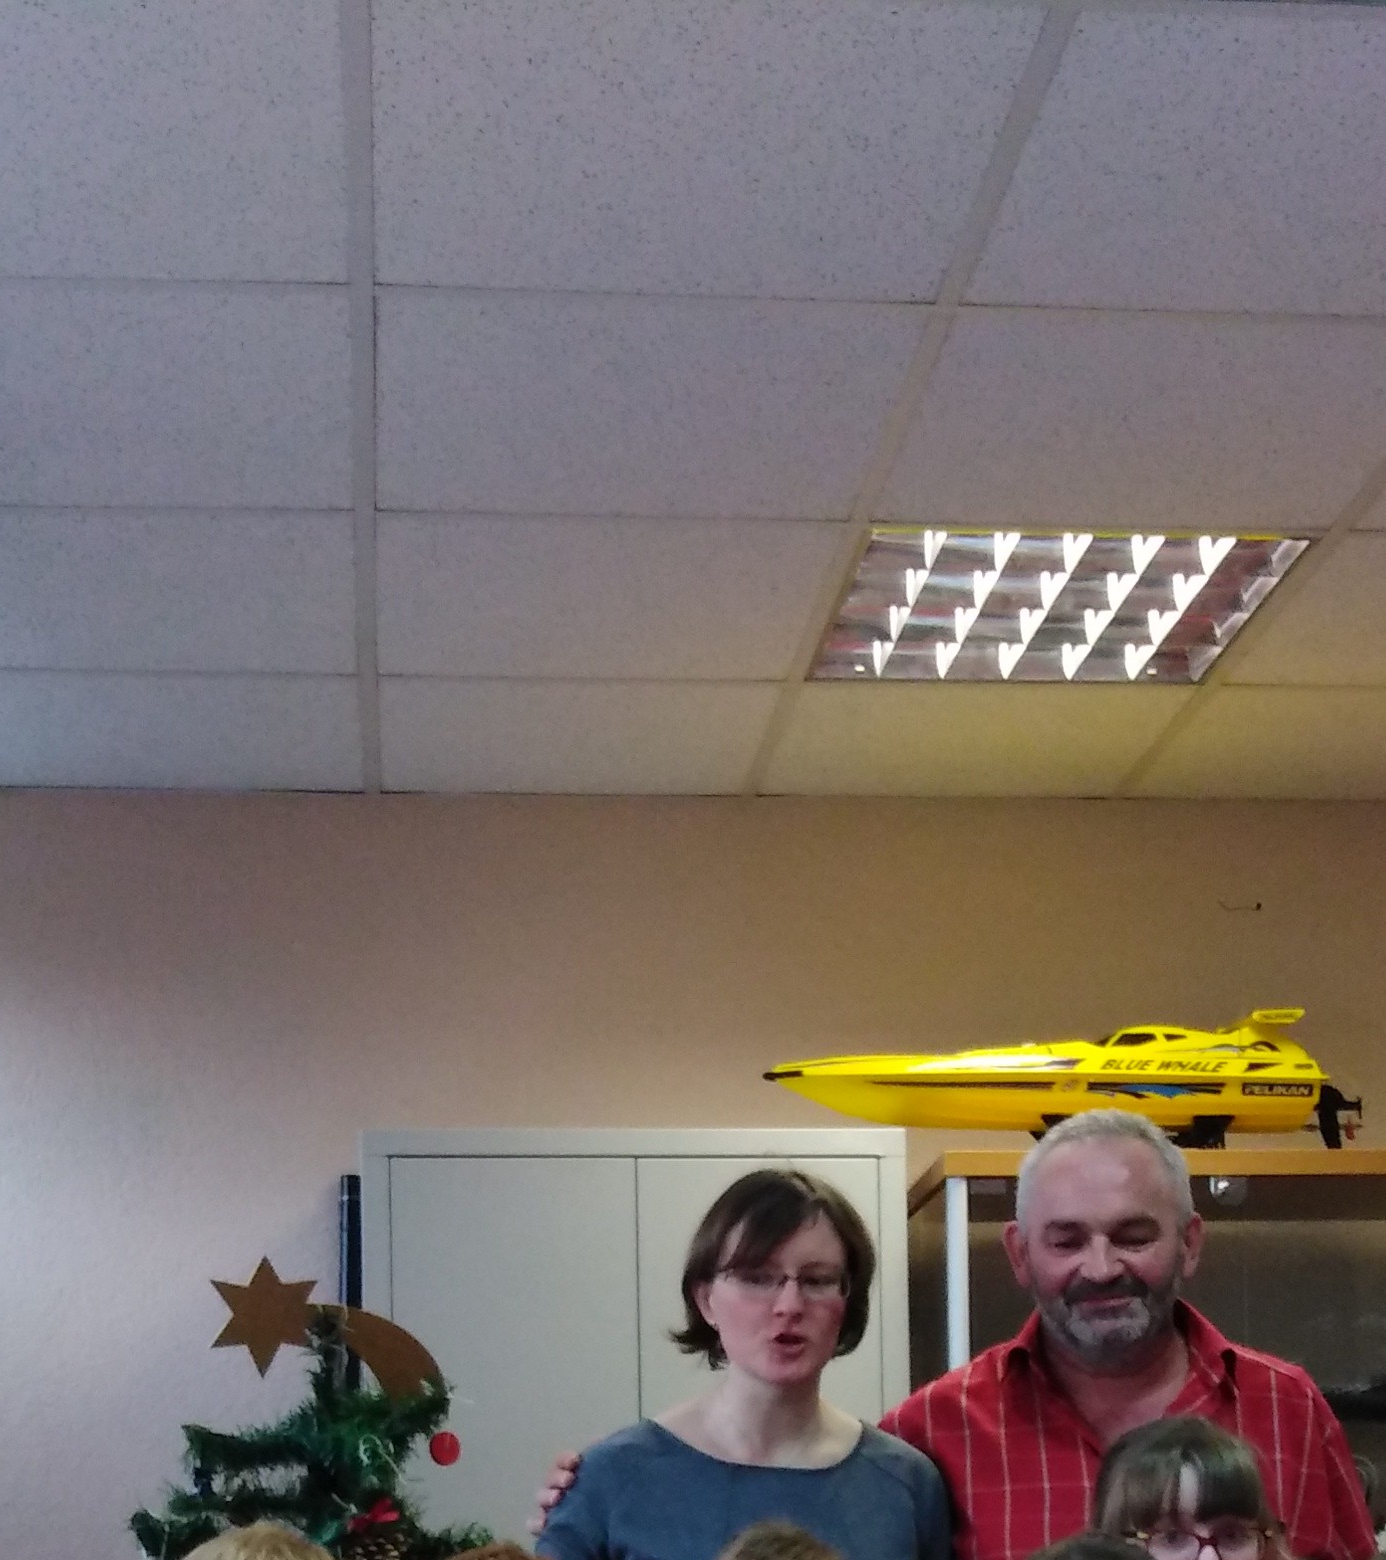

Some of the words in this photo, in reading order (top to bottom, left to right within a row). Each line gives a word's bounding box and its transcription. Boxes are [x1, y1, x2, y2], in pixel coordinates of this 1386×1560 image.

[1101, 1059, 1153, 1072] BLUE
[1157, 1060, 1229, 1074] WHALE
[1244, 1084, 1311, 1097] PELIKAN
